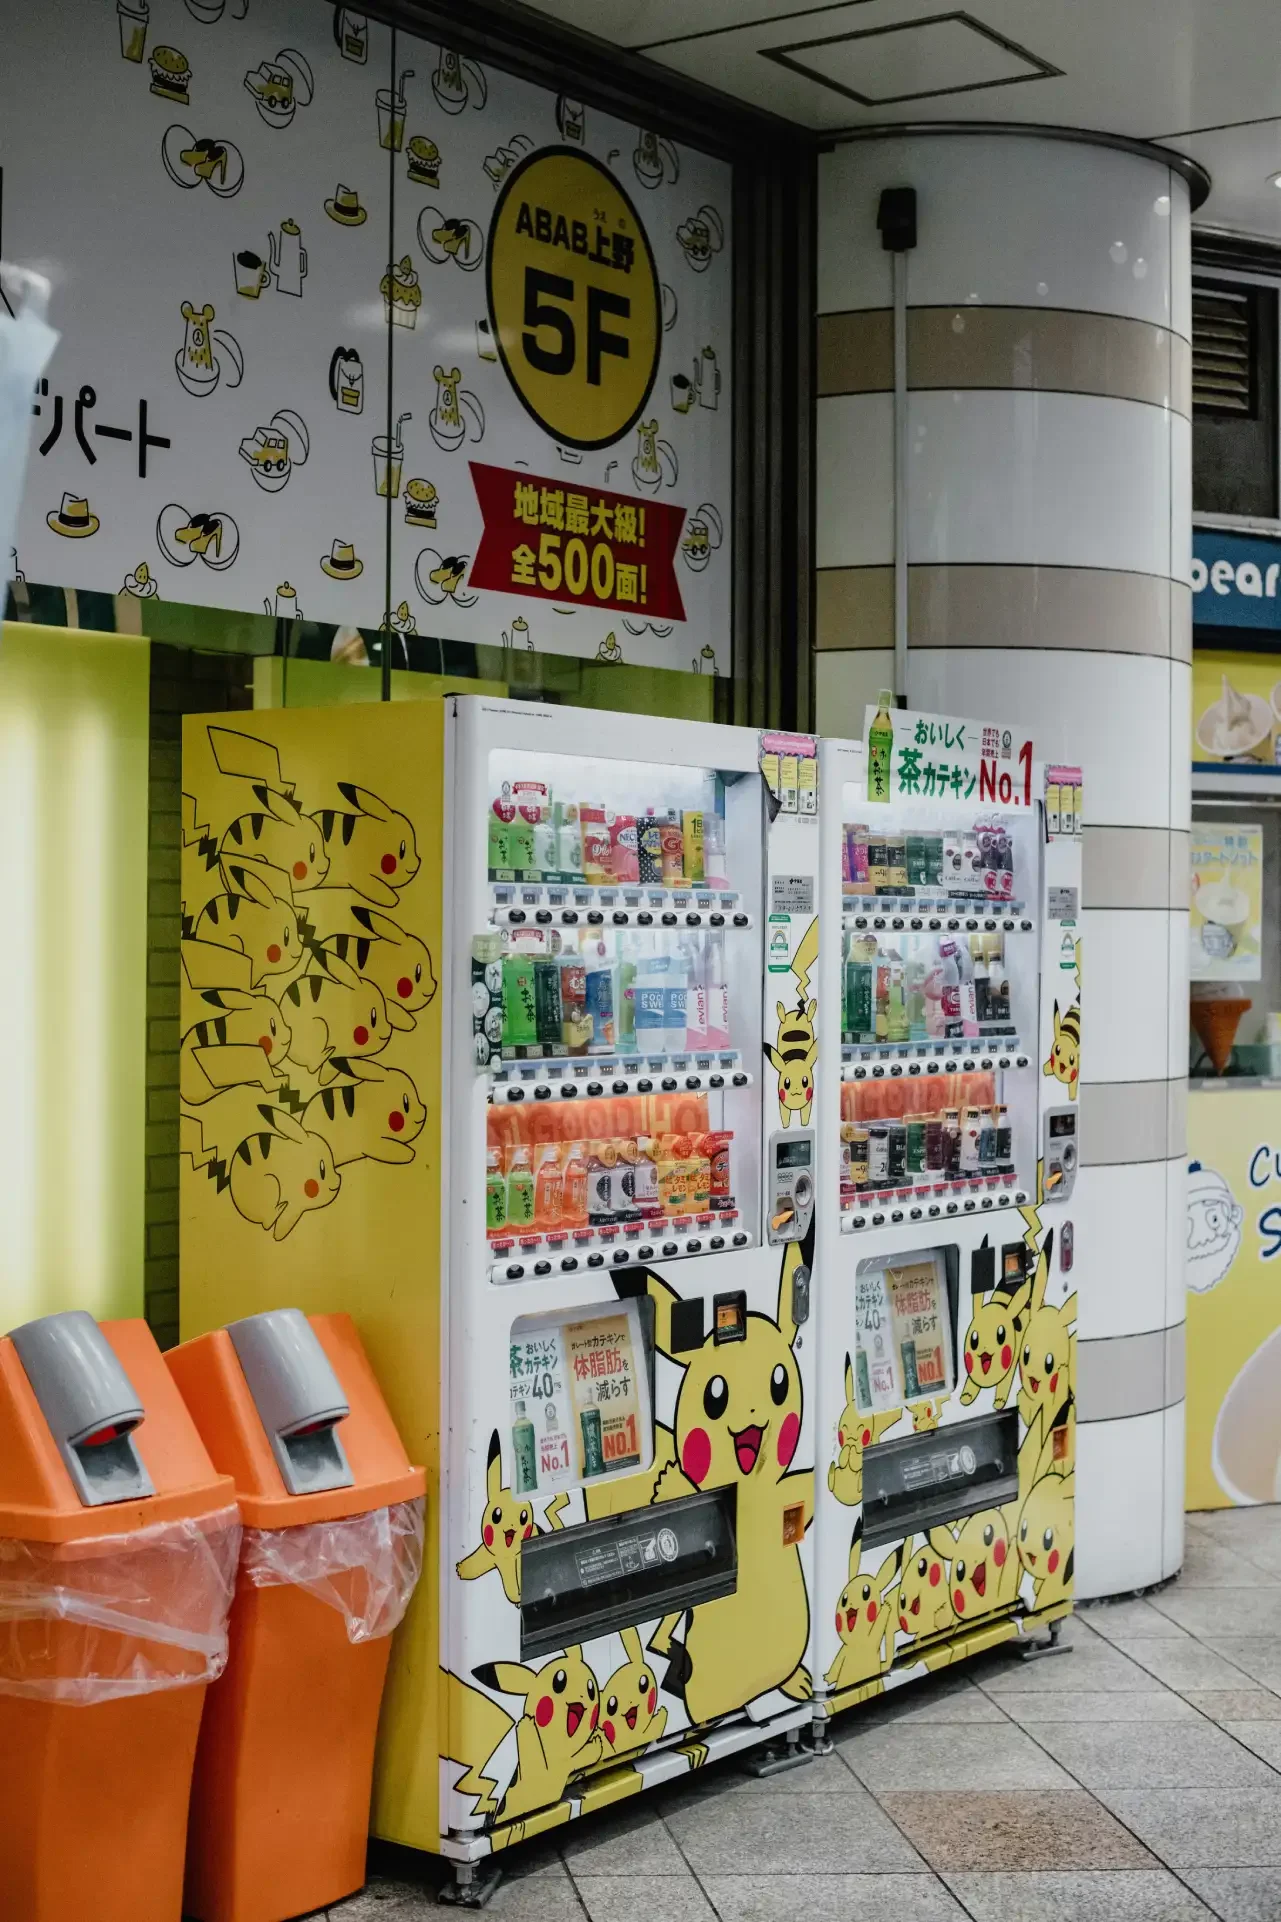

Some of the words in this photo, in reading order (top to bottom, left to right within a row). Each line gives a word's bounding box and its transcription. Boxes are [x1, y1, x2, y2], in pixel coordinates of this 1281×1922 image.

[515, 201, 635, 275] ABAB上野
[522, 266, 631, 387] 5F
[513, 481, 646, 548] 地域最大級!
[511, 533, 648, 604] 全500面!
[914, 719, 966, 750] おいしく
[897, 746, 977, 800] 茶カテキン
[979, 740, 1033, 807] No.1
[697, 991, 706, 1025] evian
[525, 1338, 556, 1355] おいしく
[573, 1348, 630, 1381] 体脂肪を
[532, 1372, 554, 1400] 40
[596, 1376, 632, 1402] 減らす
[541, 1439, 570, 1474] No.1
